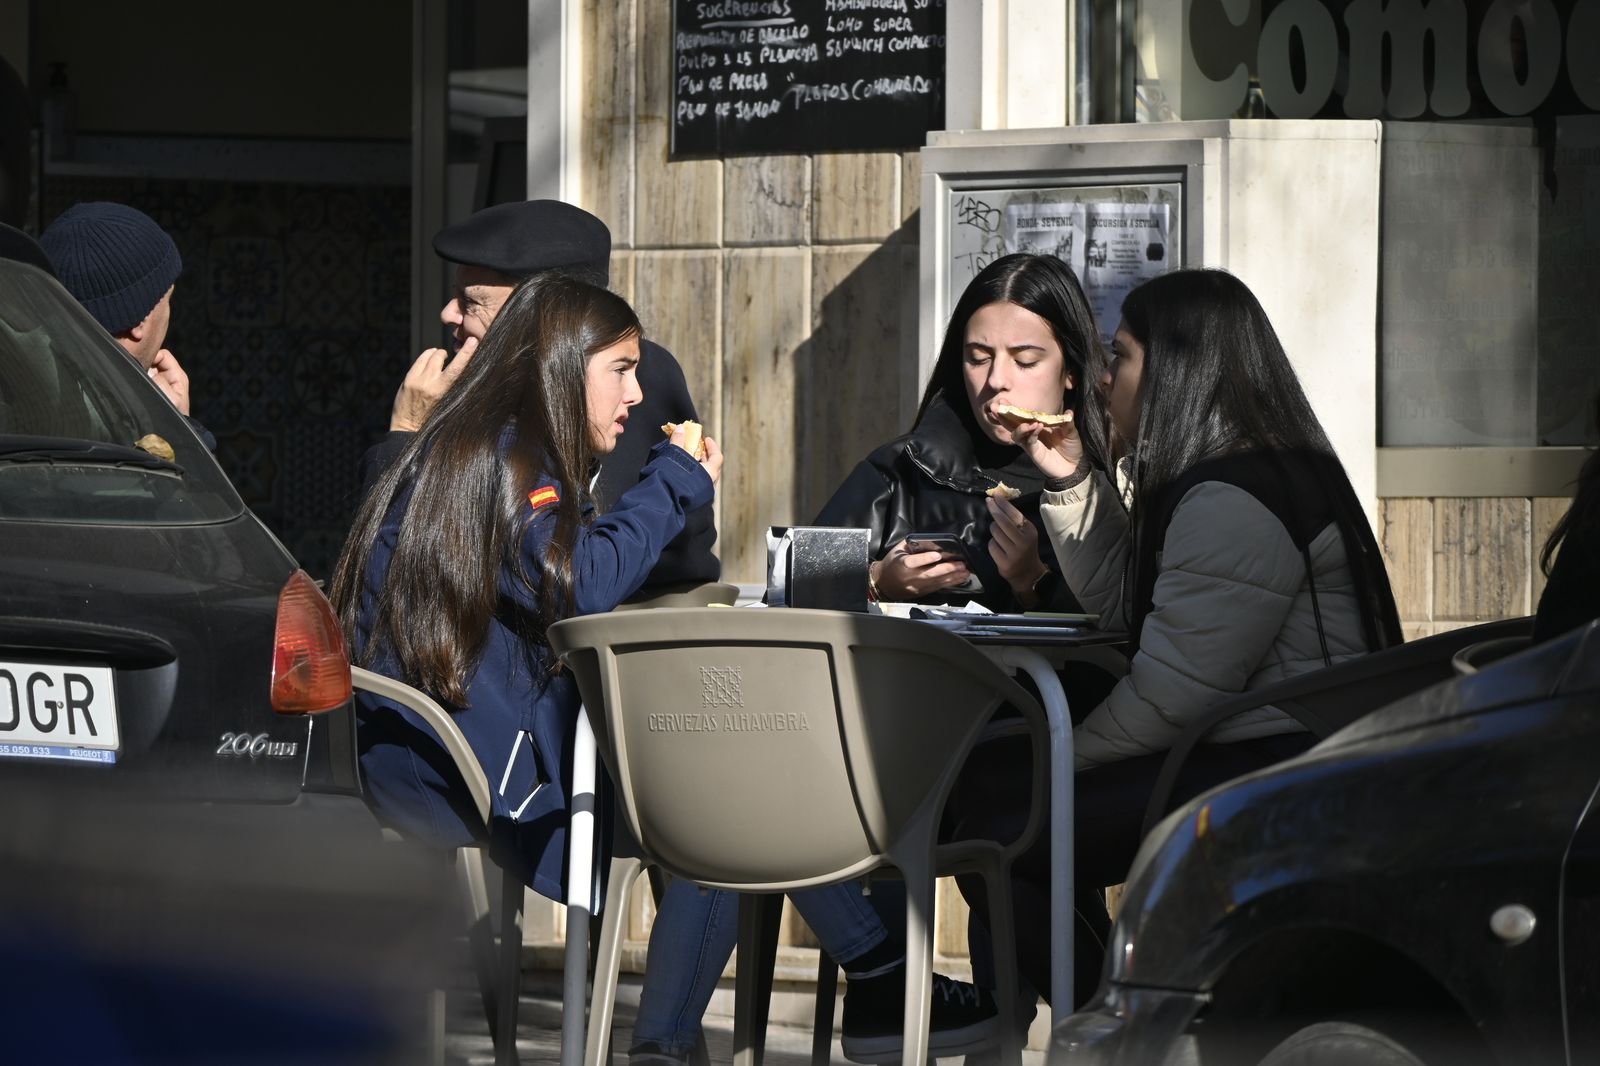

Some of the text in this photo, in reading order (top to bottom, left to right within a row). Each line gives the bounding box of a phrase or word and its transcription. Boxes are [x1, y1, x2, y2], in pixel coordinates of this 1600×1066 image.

[873, 16, 913, 32] SUPER
[740, 28, 755, 43] DE
[679, 53, 716, 72] PULPO
[648, 711, 810, 732] CERVEZAS ALHAMBRA
[12, 745, 30, 755] 050
[32, 746, 51, 756] 633
[69, 748, 102, 759] PEUGEOT
